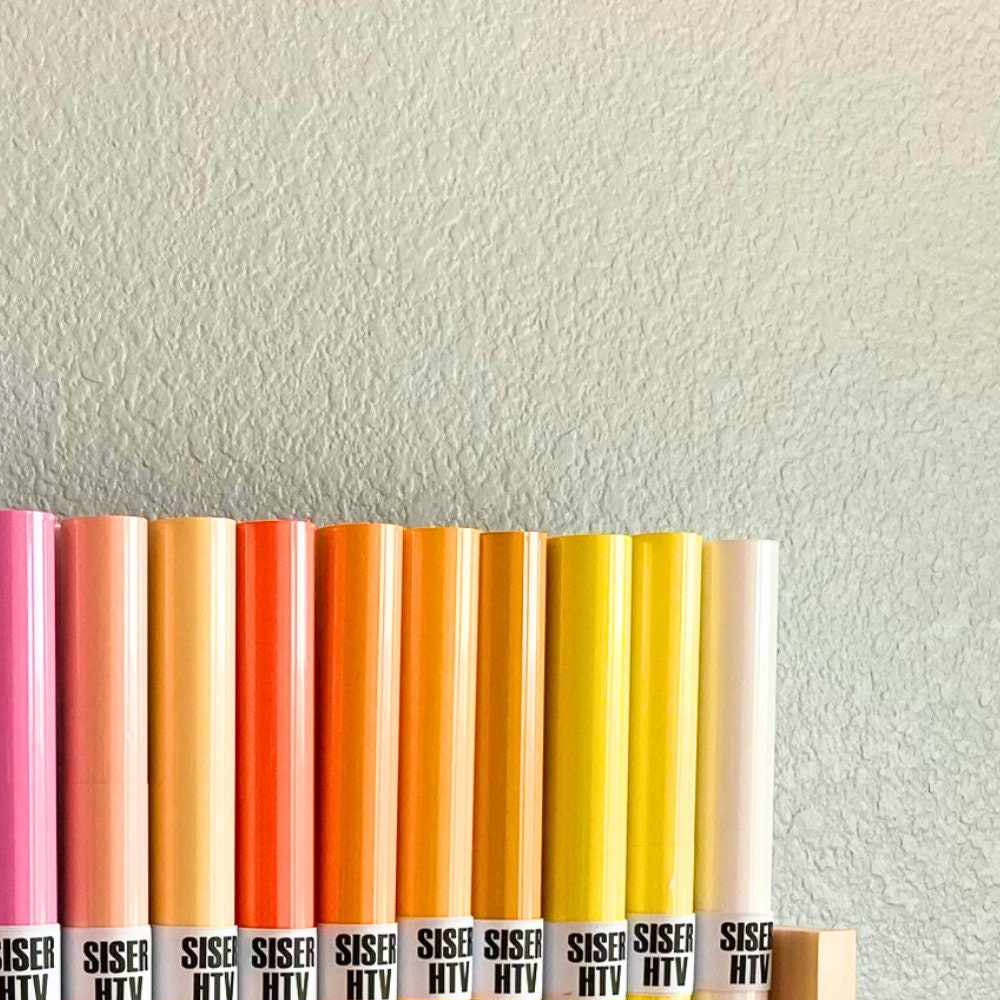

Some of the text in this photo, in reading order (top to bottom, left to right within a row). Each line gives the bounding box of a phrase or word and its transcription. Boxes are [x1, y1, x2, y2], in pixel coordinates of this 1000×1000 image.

[252, 936, 315, 968] SISER
[336, 933, 397, 966] SISER
[484, 928, 542, 960] SISER
[568, 931, 627, 963] SISER
[634, 922, 694, 953] SISER
[84, 939, 148, 973] SISER
[644, 956, 688, 987] HTV
[730, 954, 770, 984] HTV
[347, 968, 391, 1000] HTV
[429, 962, 469, 994] HTV
[495, 963, 538, 994] HTV
[579, 965, 622, 996] HTV
